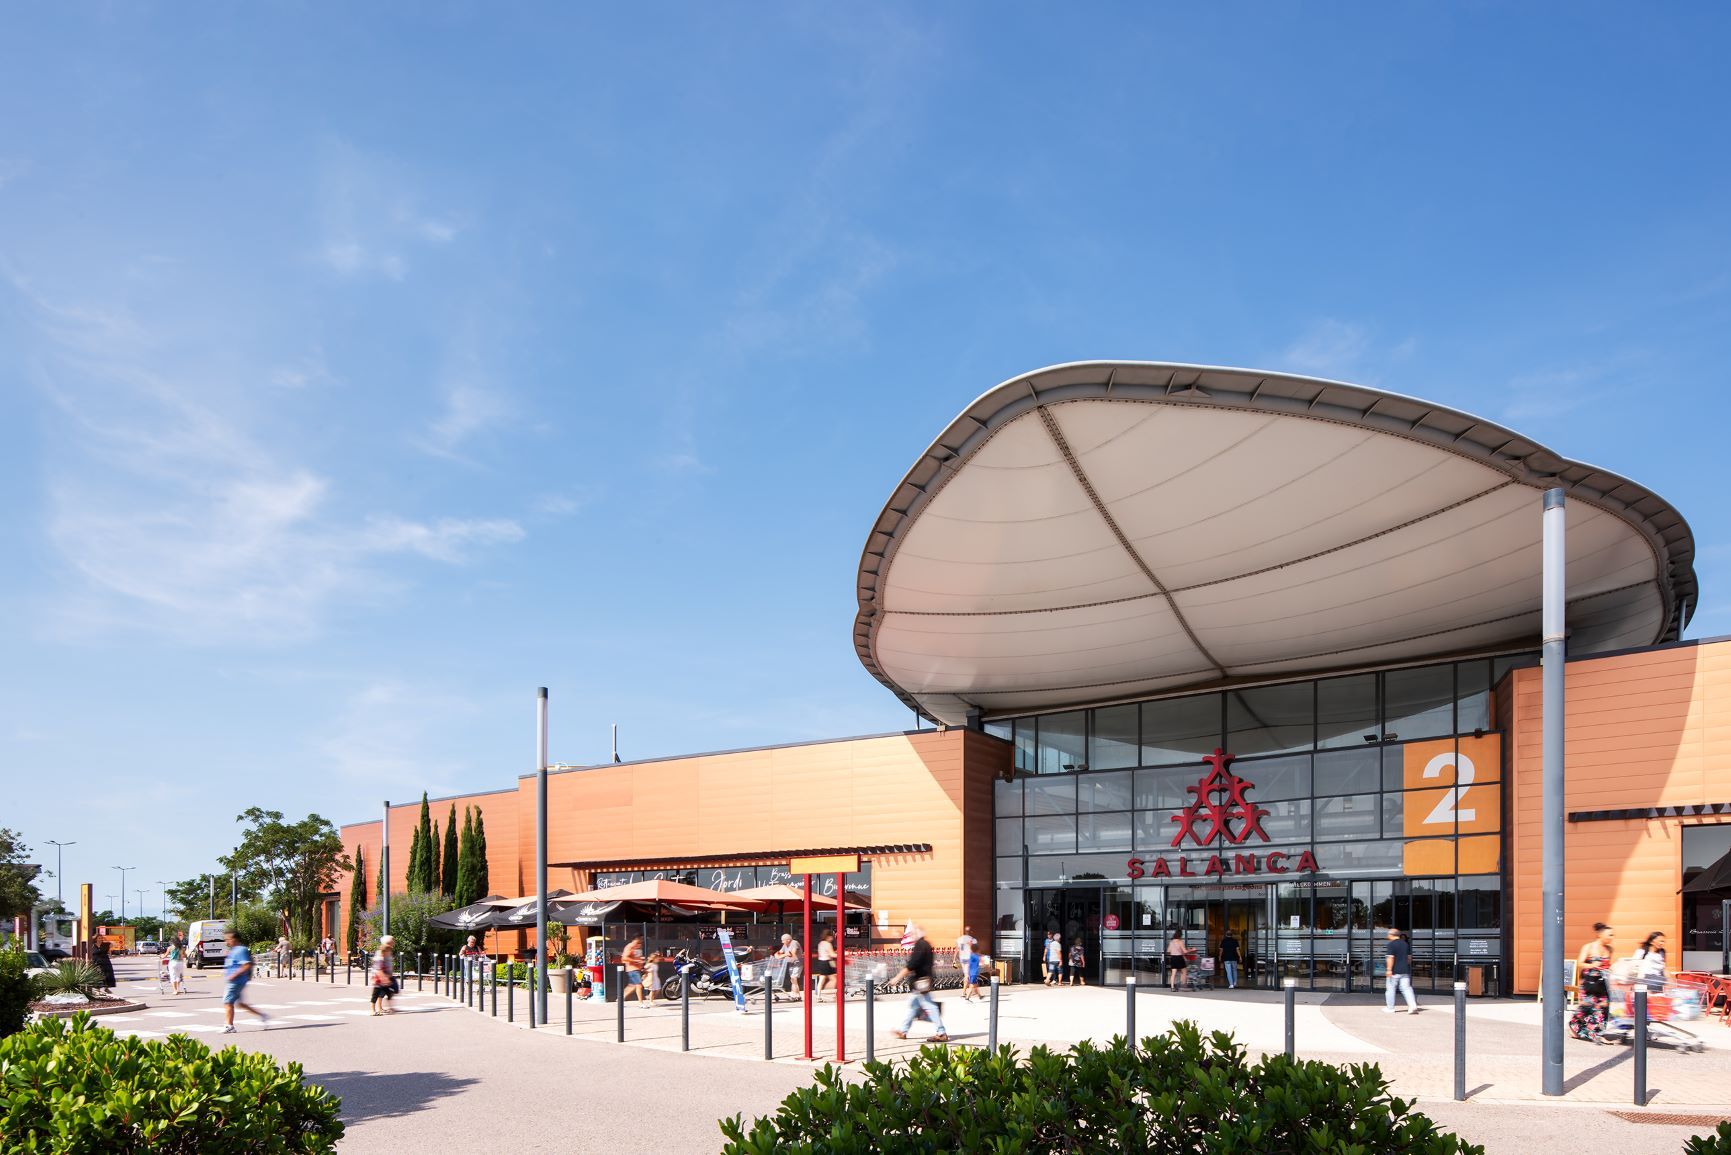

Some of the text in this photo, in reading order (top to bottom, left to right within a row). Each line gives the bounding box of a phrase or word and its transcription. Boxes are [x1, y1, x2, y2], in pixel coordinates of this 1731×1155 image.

[1423, 752, 1476, 824] 2
[1127, 850, 1319, 880] SALANCA
[710, 869, 752, 892] Jordi
